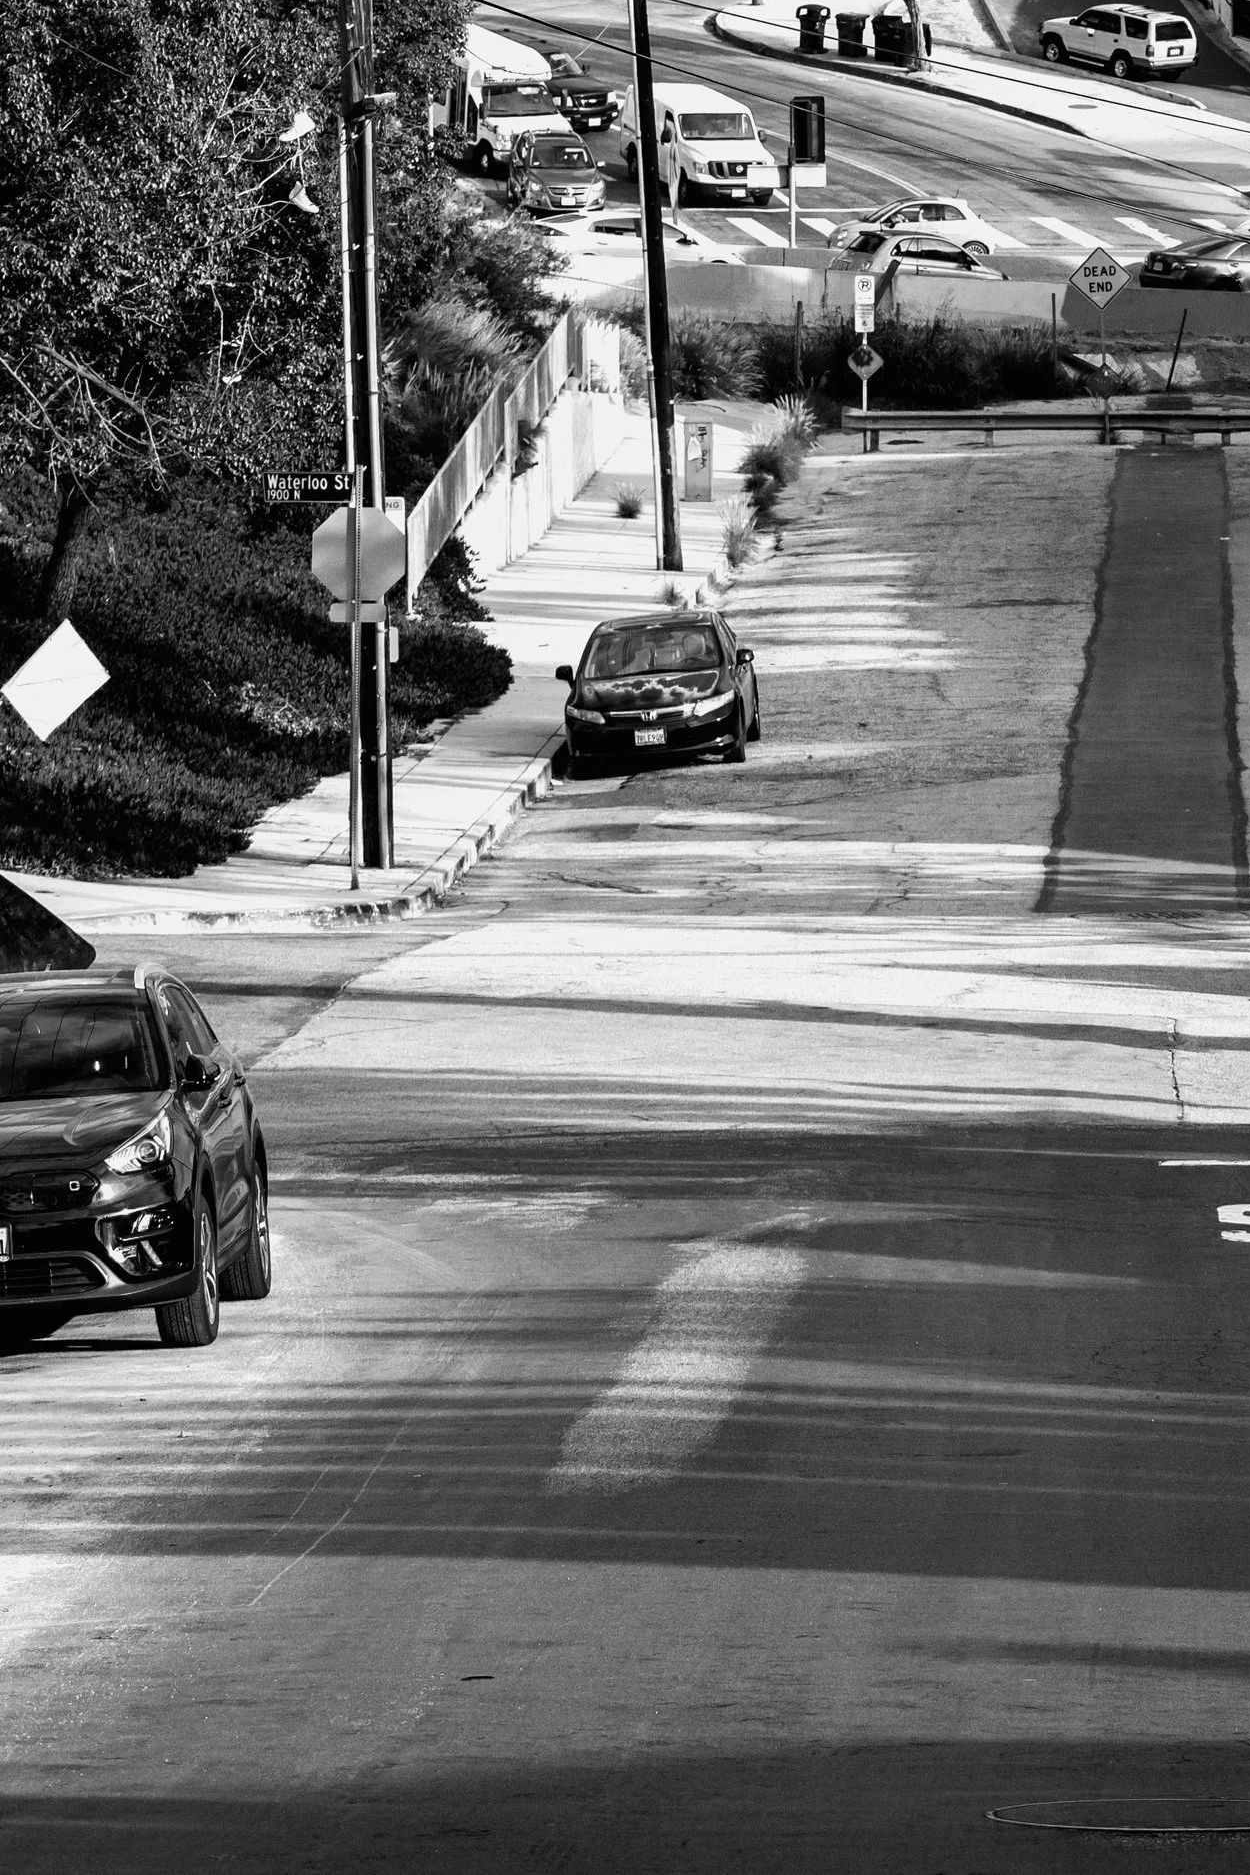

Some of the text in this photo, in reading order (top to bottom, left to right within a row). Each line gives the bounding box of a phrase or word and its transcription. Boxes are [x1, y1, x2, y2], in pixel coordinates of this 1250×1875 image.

[1083, 265, 1117, 278] DEAD
[1089, 281, 1113, 293] END
[267, 473, 350, 490] Waterloo St
[267, 489, 301, 501] 1900 N
